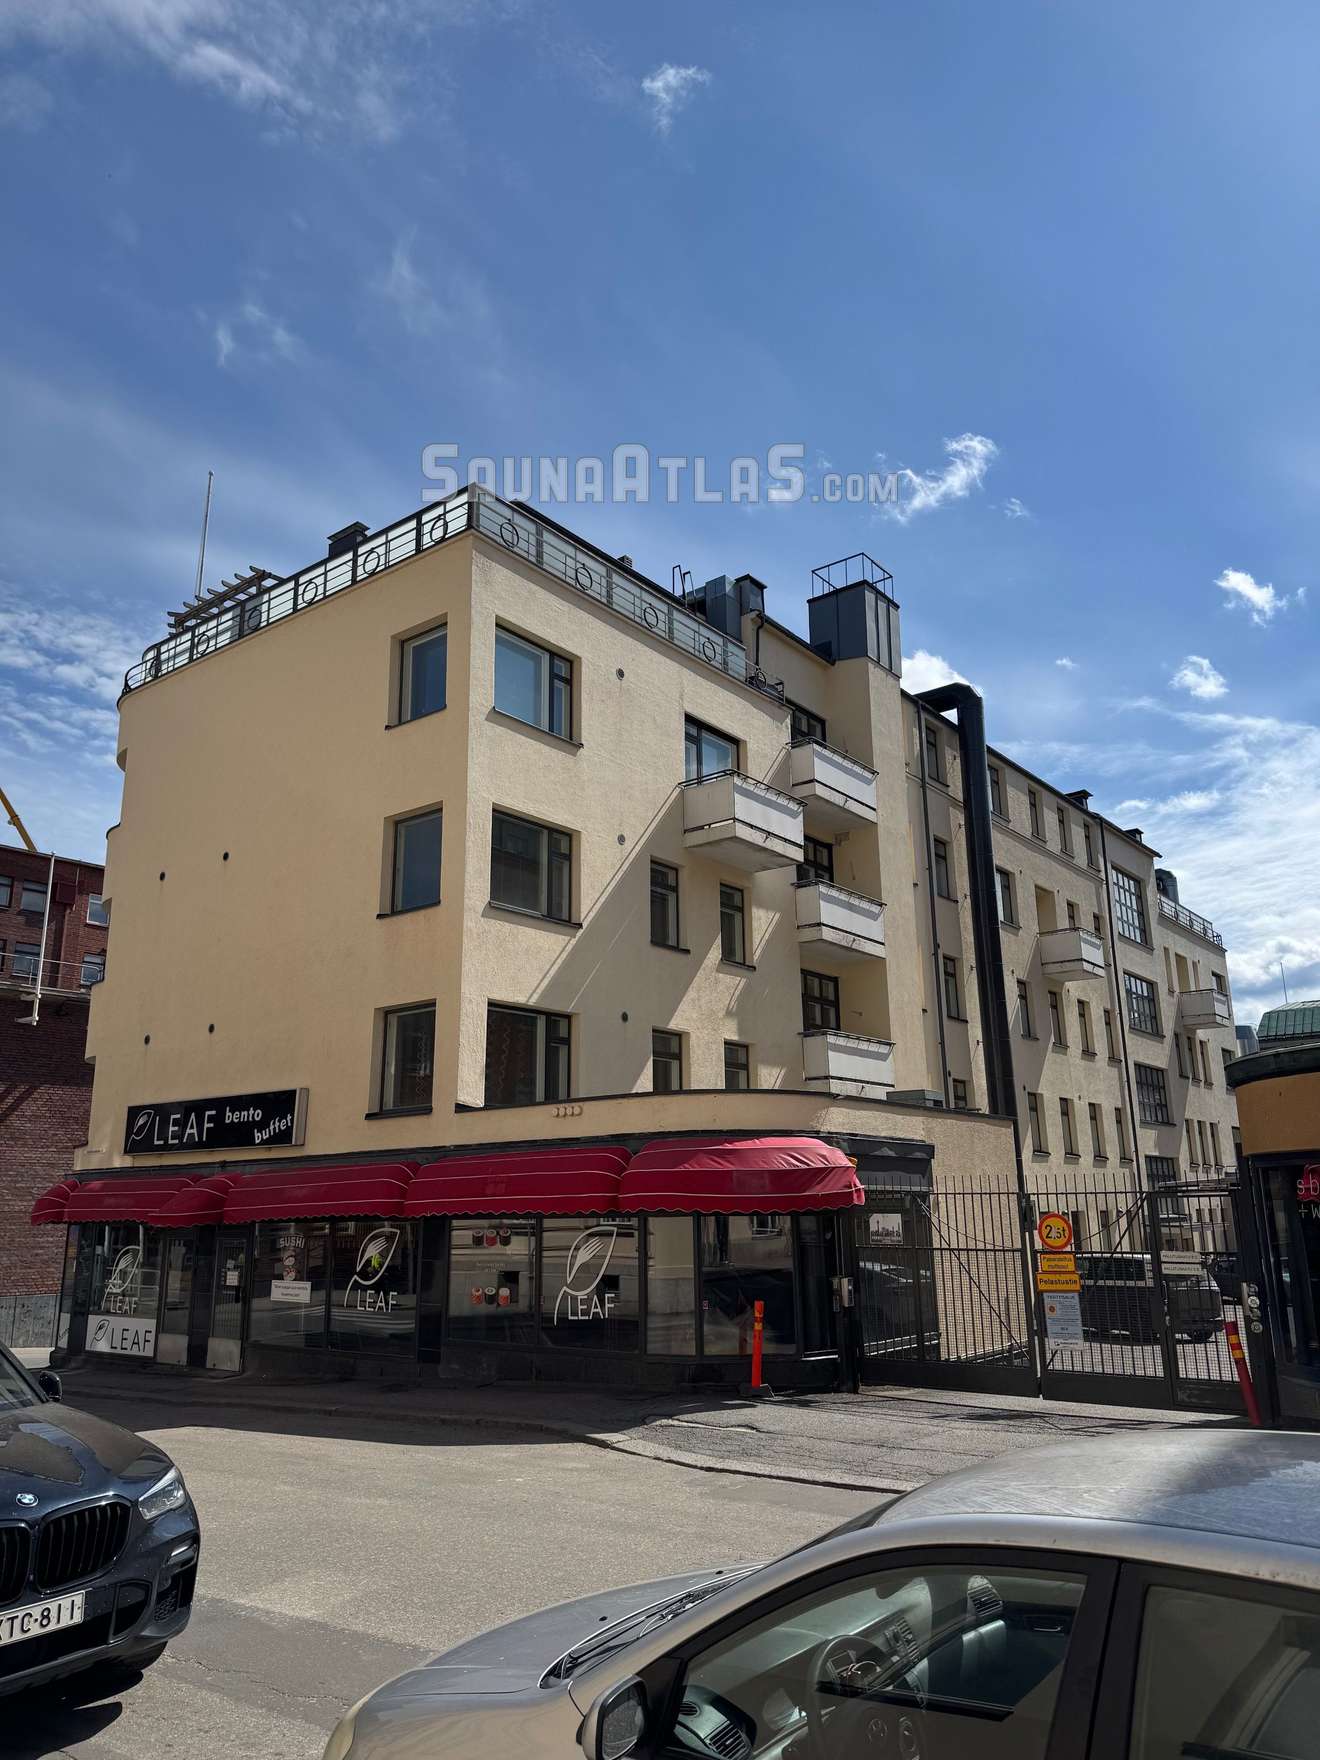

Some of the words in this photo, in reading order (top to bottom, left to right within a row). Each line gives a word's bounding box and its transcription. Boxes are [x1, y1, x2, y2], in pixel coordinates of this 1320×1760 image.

[153, 1110, 217, 1145] LEAF
[225, 1106, 263, 1124] bento
[254, 1113, 293, 1144] buffet
[279, 1236, 305, 1249] SUSHI
[110, 1296, 139, 1315] LEAF
[357, 1288, 398, 1313] LEAF
[567, 1293, 615, 1320] LEAF
[110, 1327, 152, 1353] LEAF
